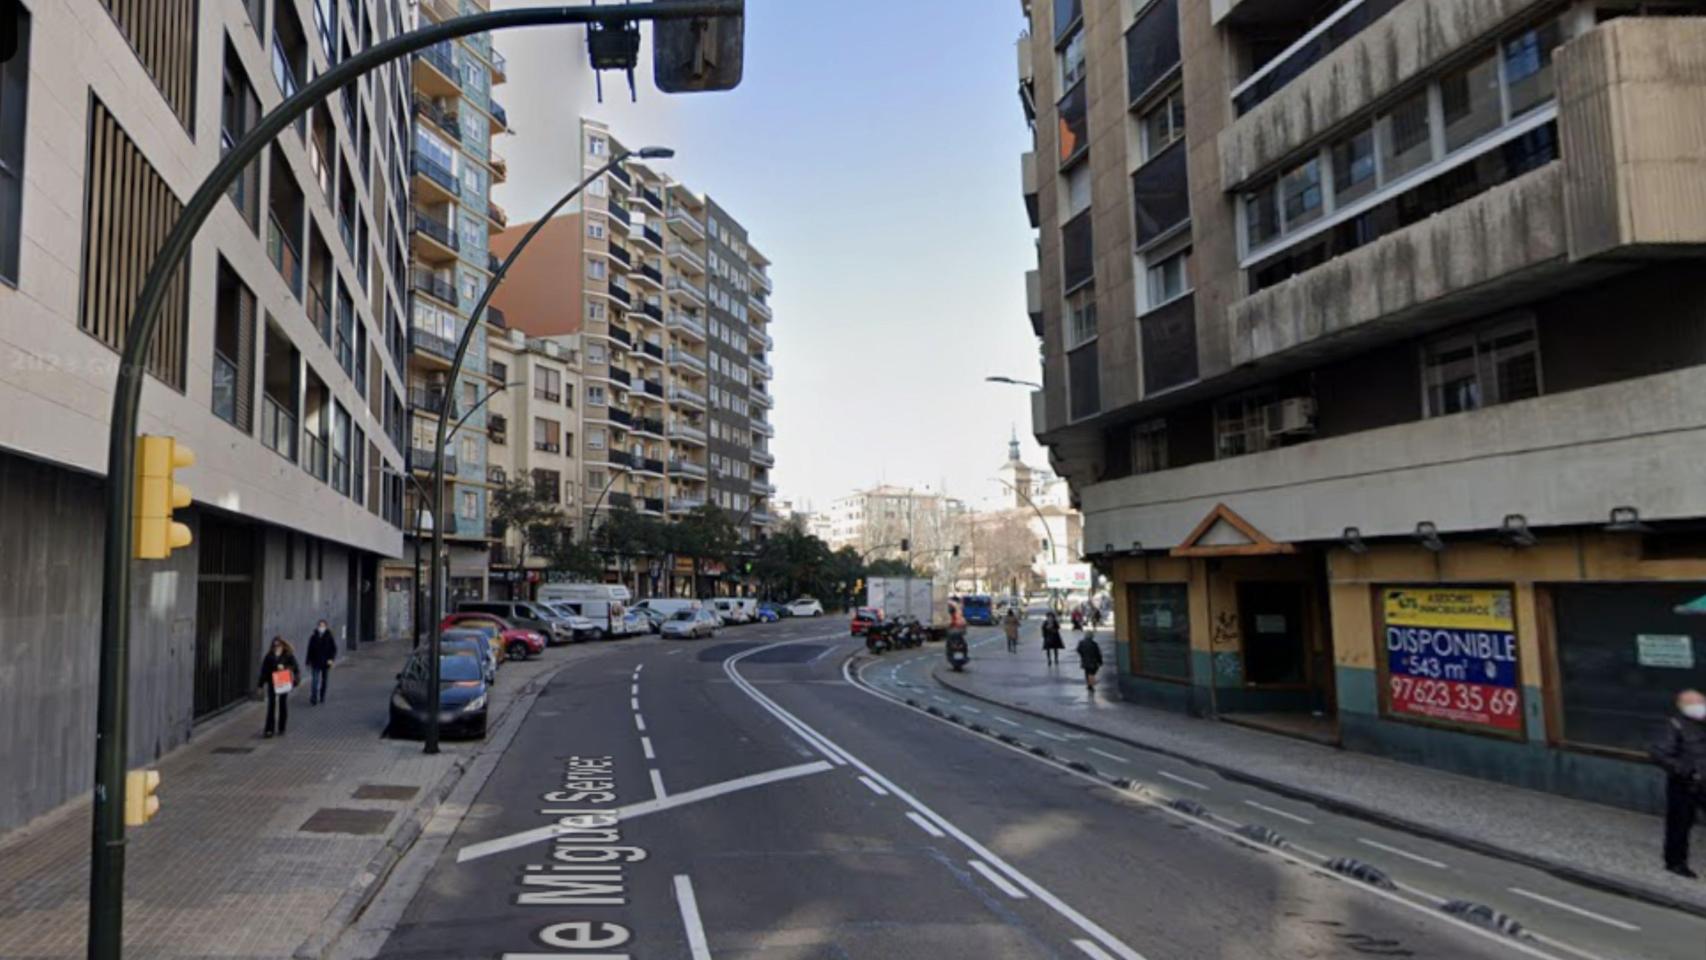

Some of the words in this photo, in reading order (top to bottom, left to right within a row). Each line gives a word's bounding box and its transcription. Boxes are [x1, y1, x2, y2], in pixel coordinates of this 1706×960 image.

[1387, 627, 1516, 662] DISPONIBLE
[1408, 655, 1441, 678] 543
[1455, 684, 1484, 711] 35
[1489, 689, 1518, 715] 69
